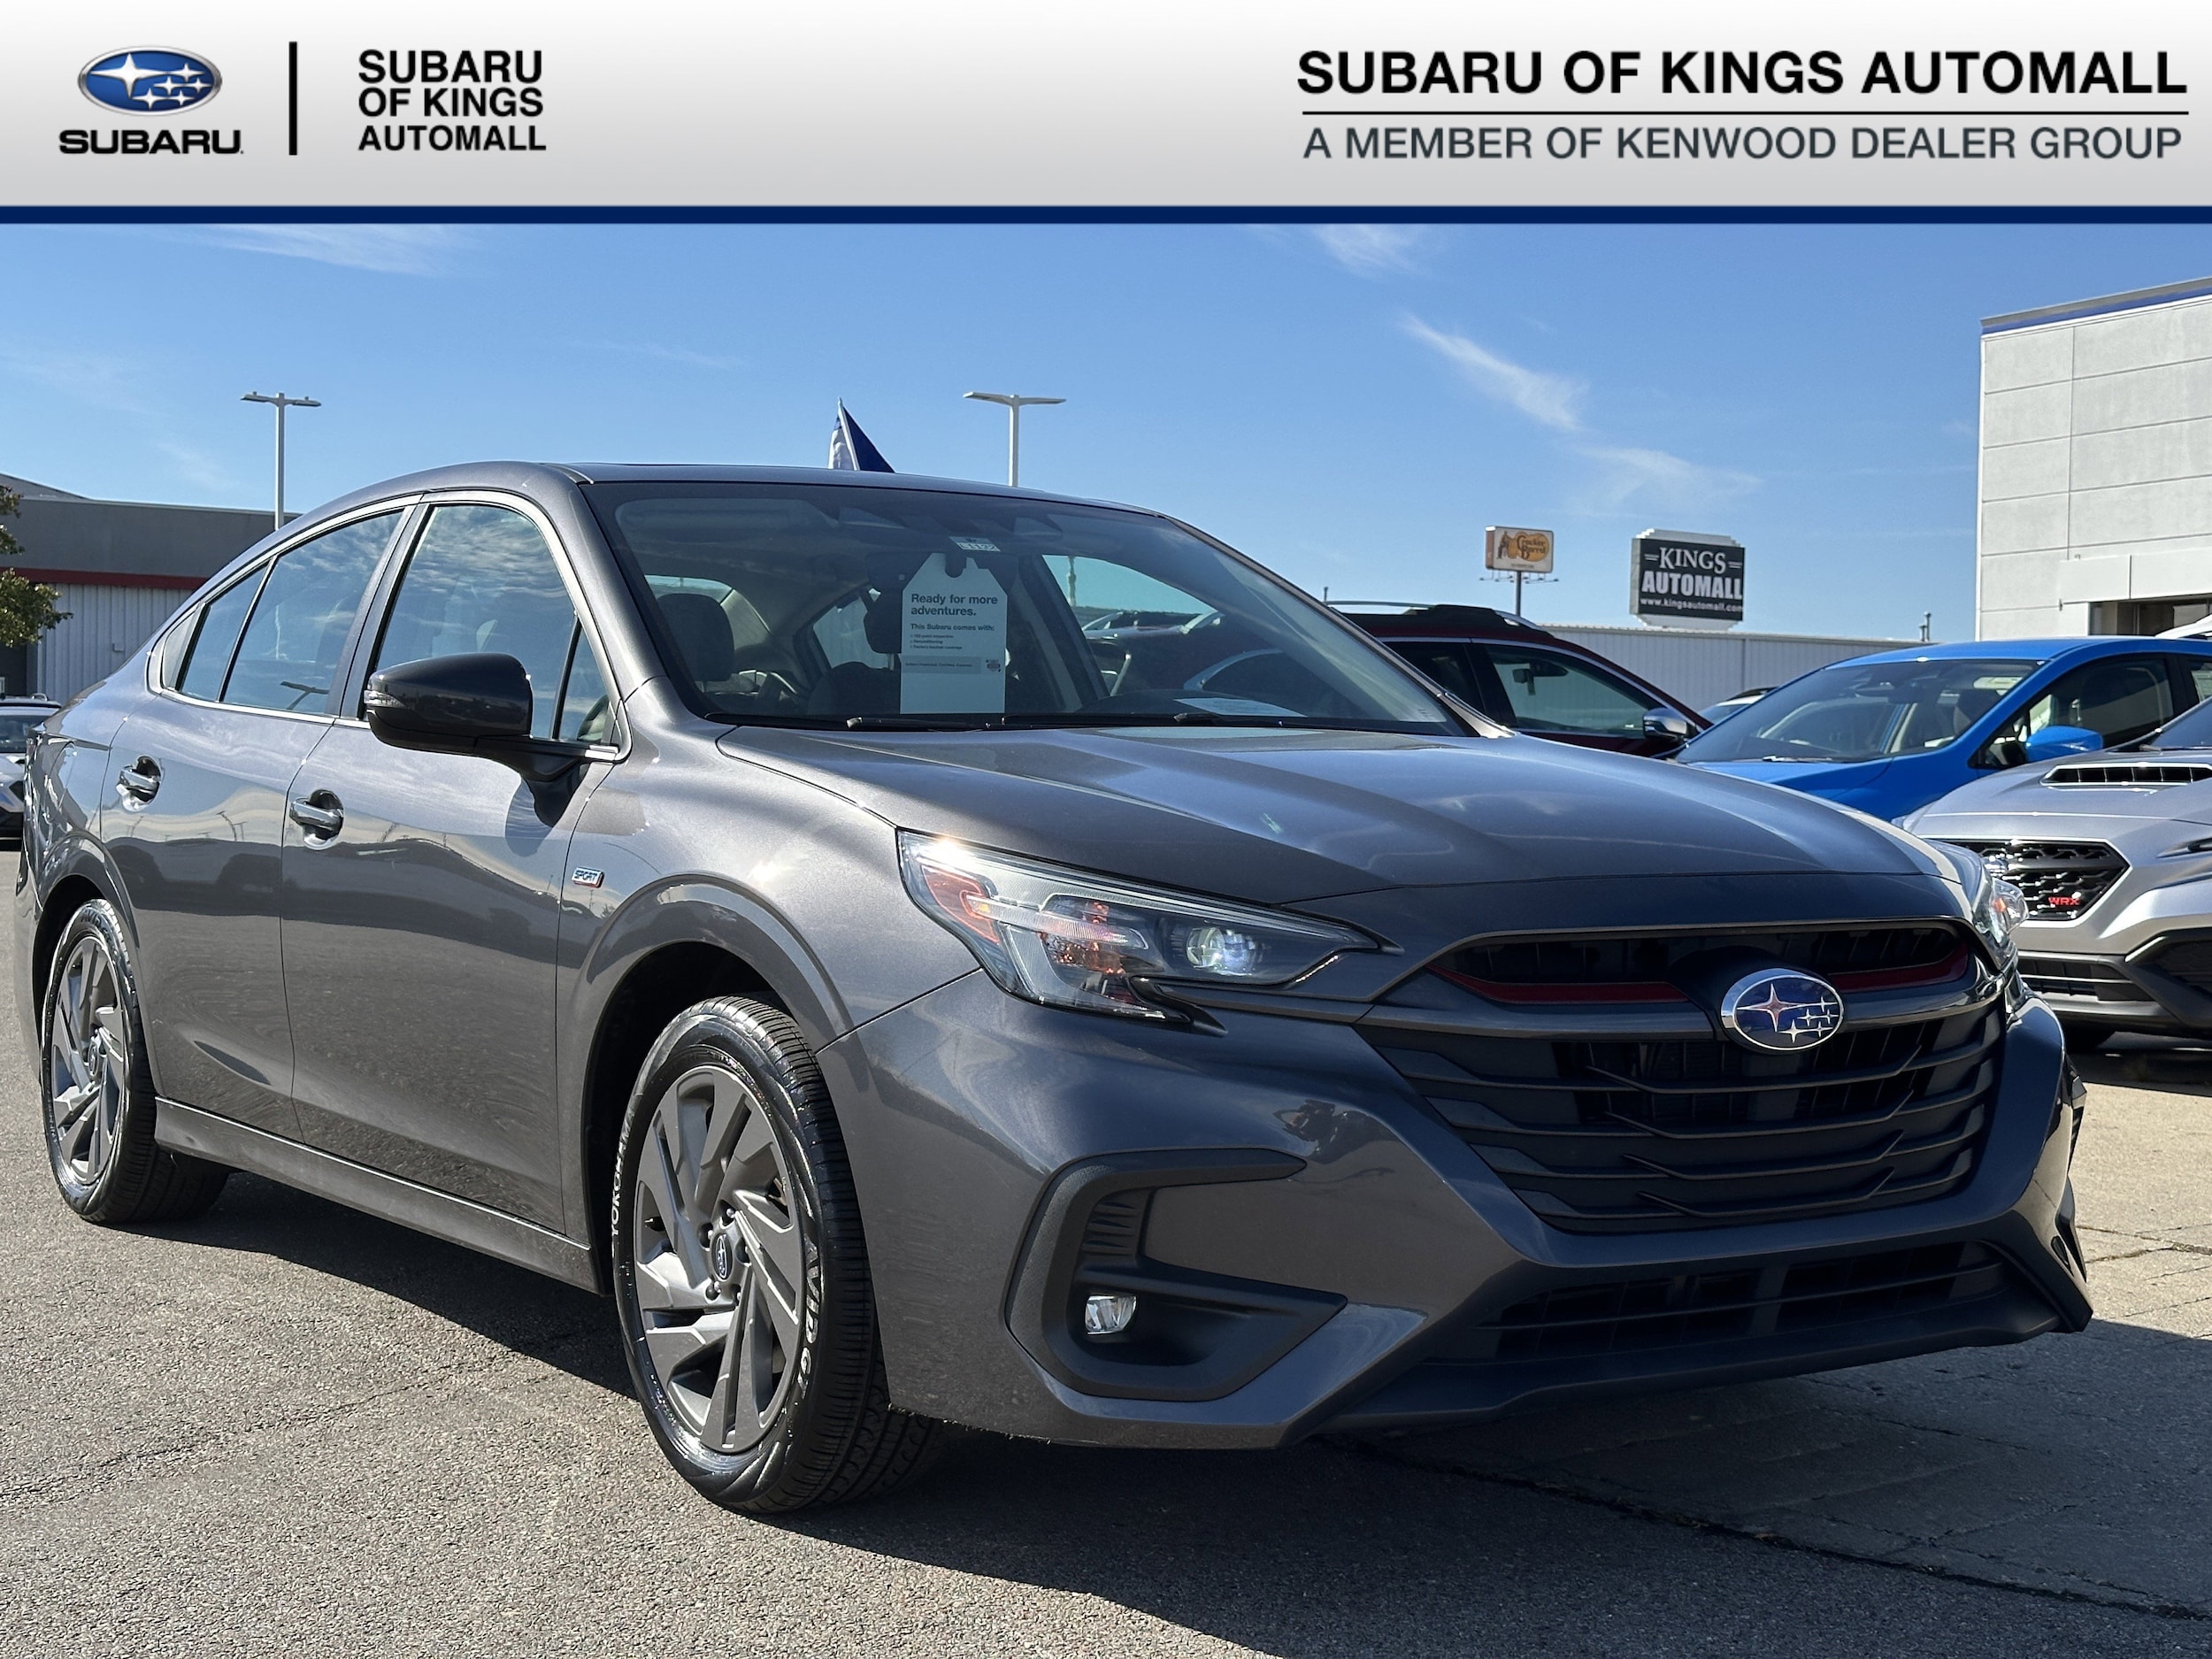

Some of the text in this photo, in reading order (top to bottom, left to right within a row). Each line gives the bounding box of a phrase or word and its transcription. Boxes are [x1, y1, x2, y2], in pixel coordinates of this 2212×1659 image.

[1659, 547, 1726, 574] KINGS
[1641, 570, 1742, 600] AUTOMALL
[911, 594, 946, 605] Ready
[949, 595, 965, 604] for
[910, 605, 977, 616] adventures.
[2047, 896, 2080, 906] WRX
